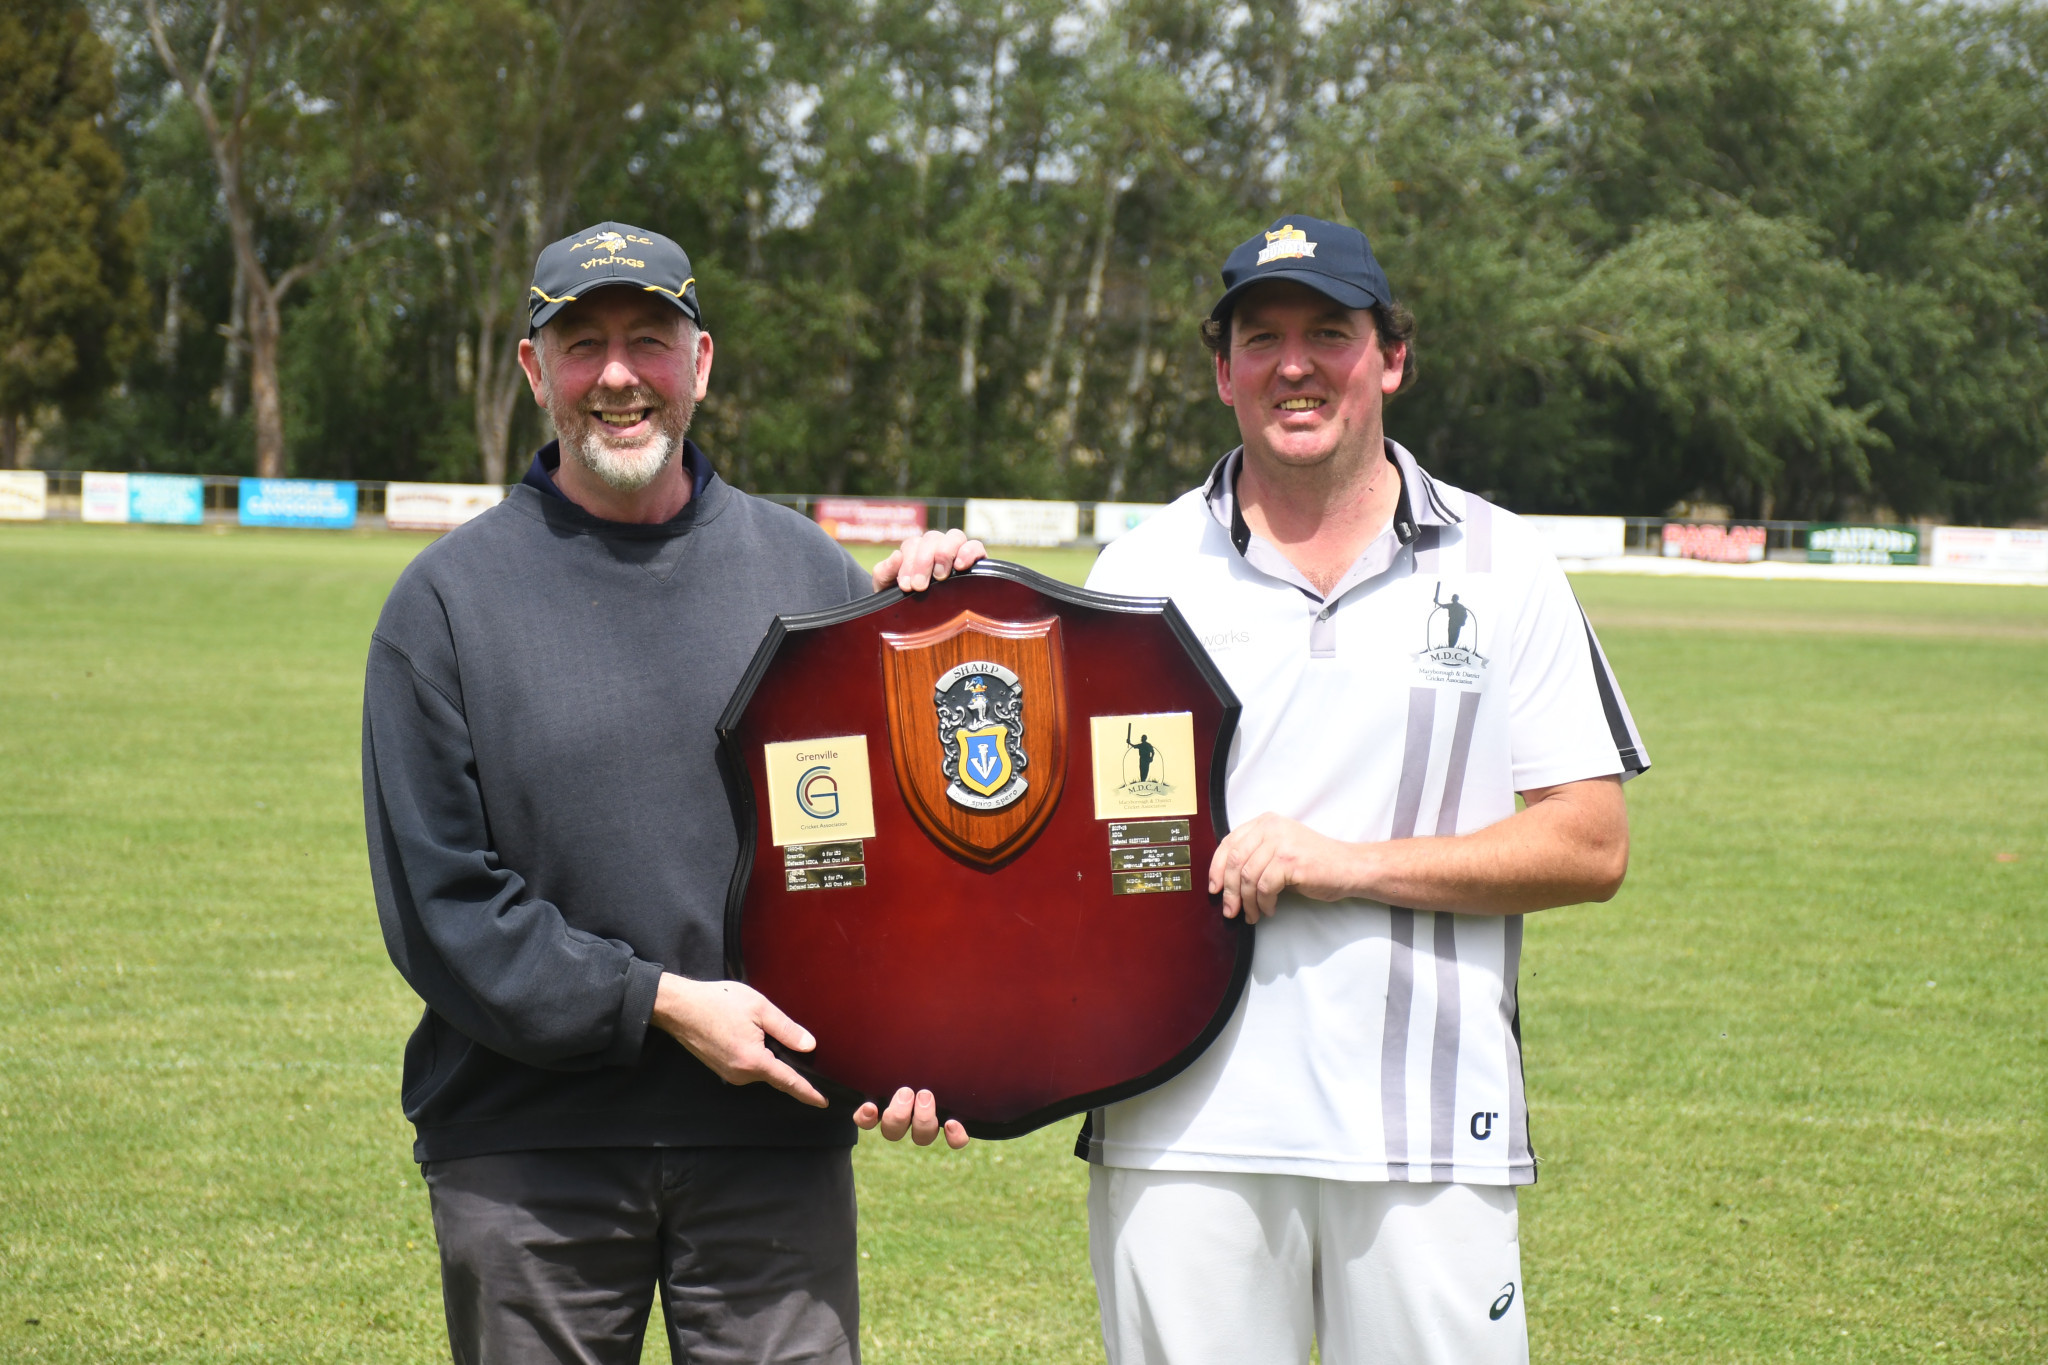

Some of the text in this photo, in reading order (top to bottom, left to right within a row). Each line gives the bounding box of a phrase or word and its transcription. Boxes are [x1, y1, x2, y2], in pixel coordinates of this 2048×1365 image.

[953, 662, 1000, 680] SHARP
[1419, 667, 1454, 677] Maryborough
[1462, 671, 1480, 679] District
[796, 750, 839, 763] Grenville
[800, 821, 848, 831] Cricket Association
